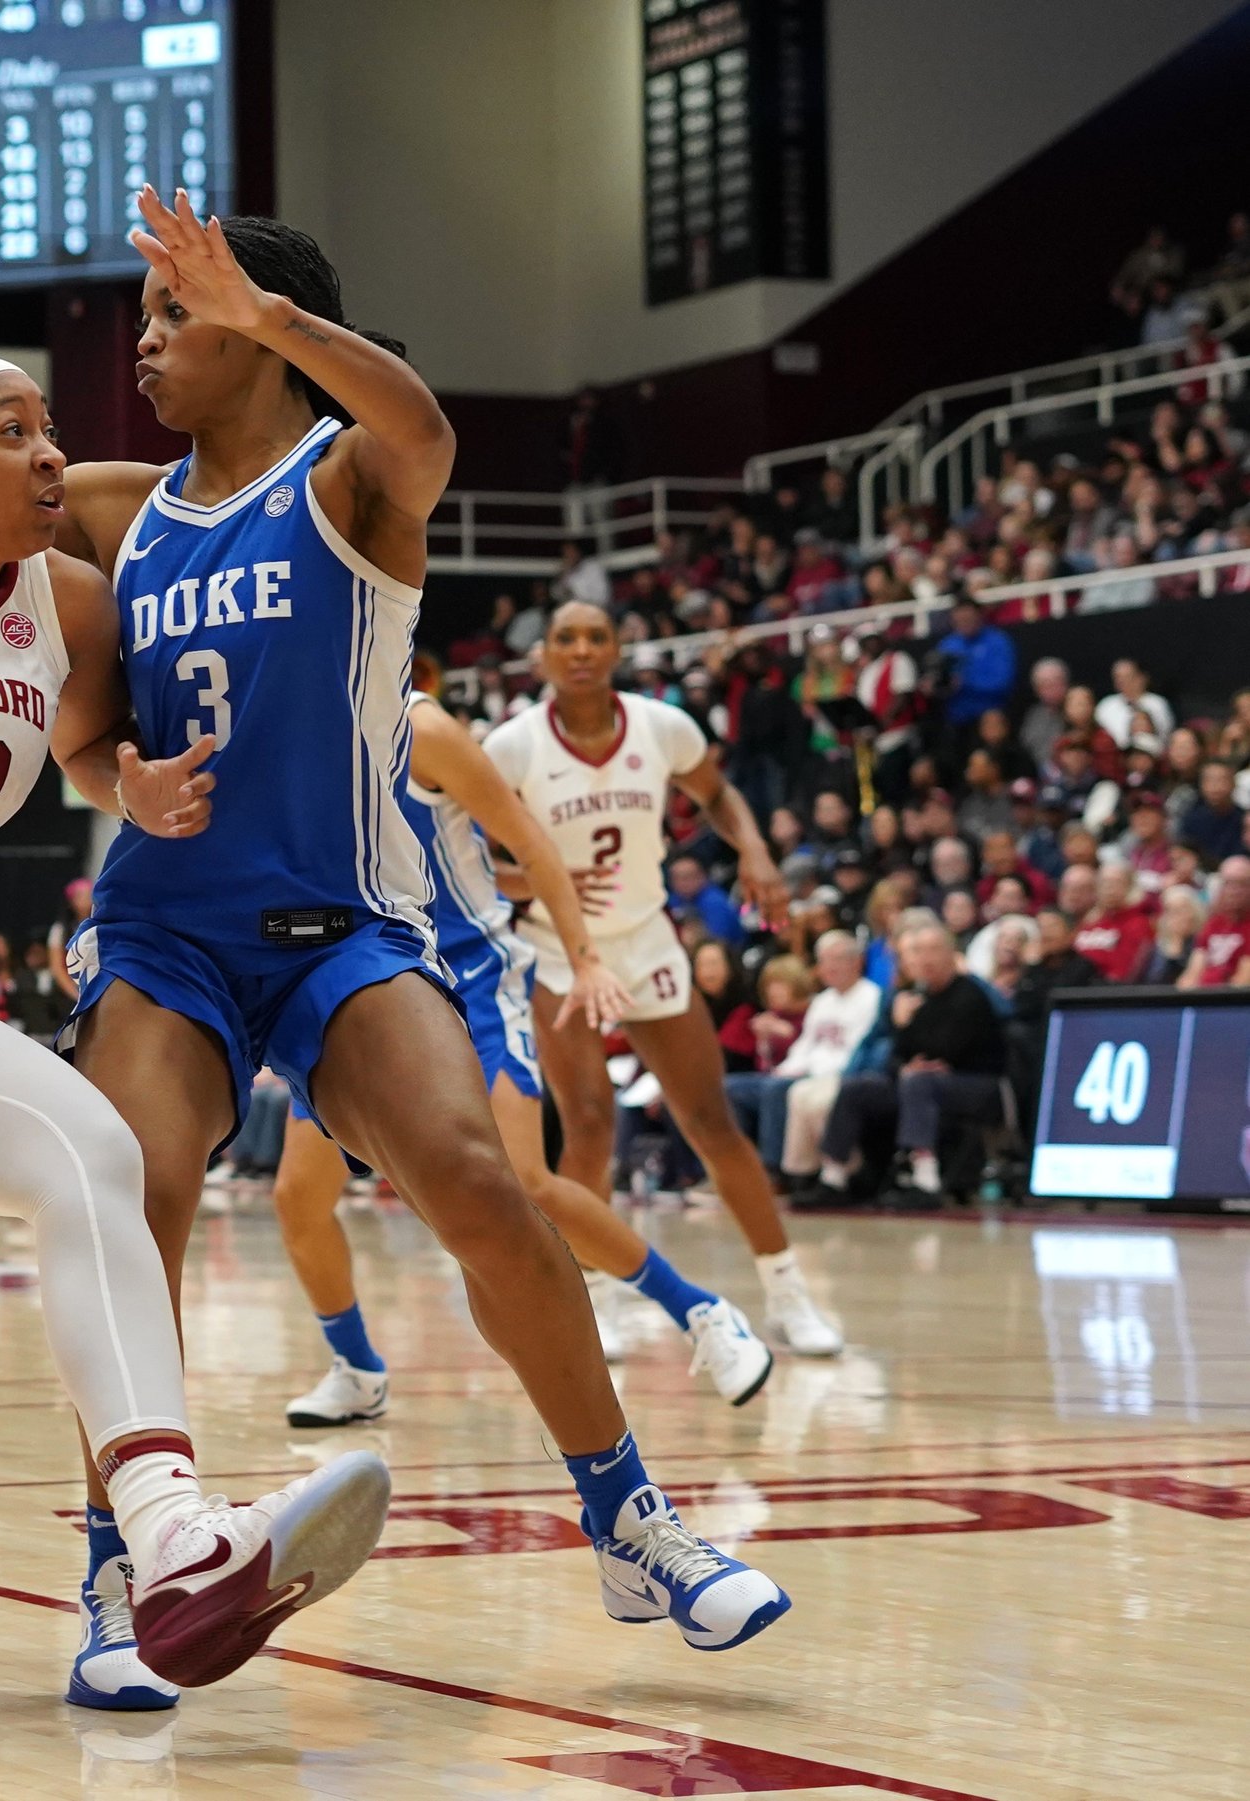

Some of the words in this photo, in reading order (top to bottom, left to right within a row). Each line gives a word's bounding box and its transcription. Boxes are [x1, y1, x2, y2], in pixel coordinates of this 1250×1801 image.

[131, 561, 292, 654] DUKE
[6, 623, 31, 634] ACC
[175, 649, 232, 751] 3
[552, 791, 653, 825] STANFORD
[592, 825, 622, 869] 2
[331, 916, 346, 928] 44
[1074, 1041, 1149, 1125] 40
[632, 1490, 657, 1520] D
